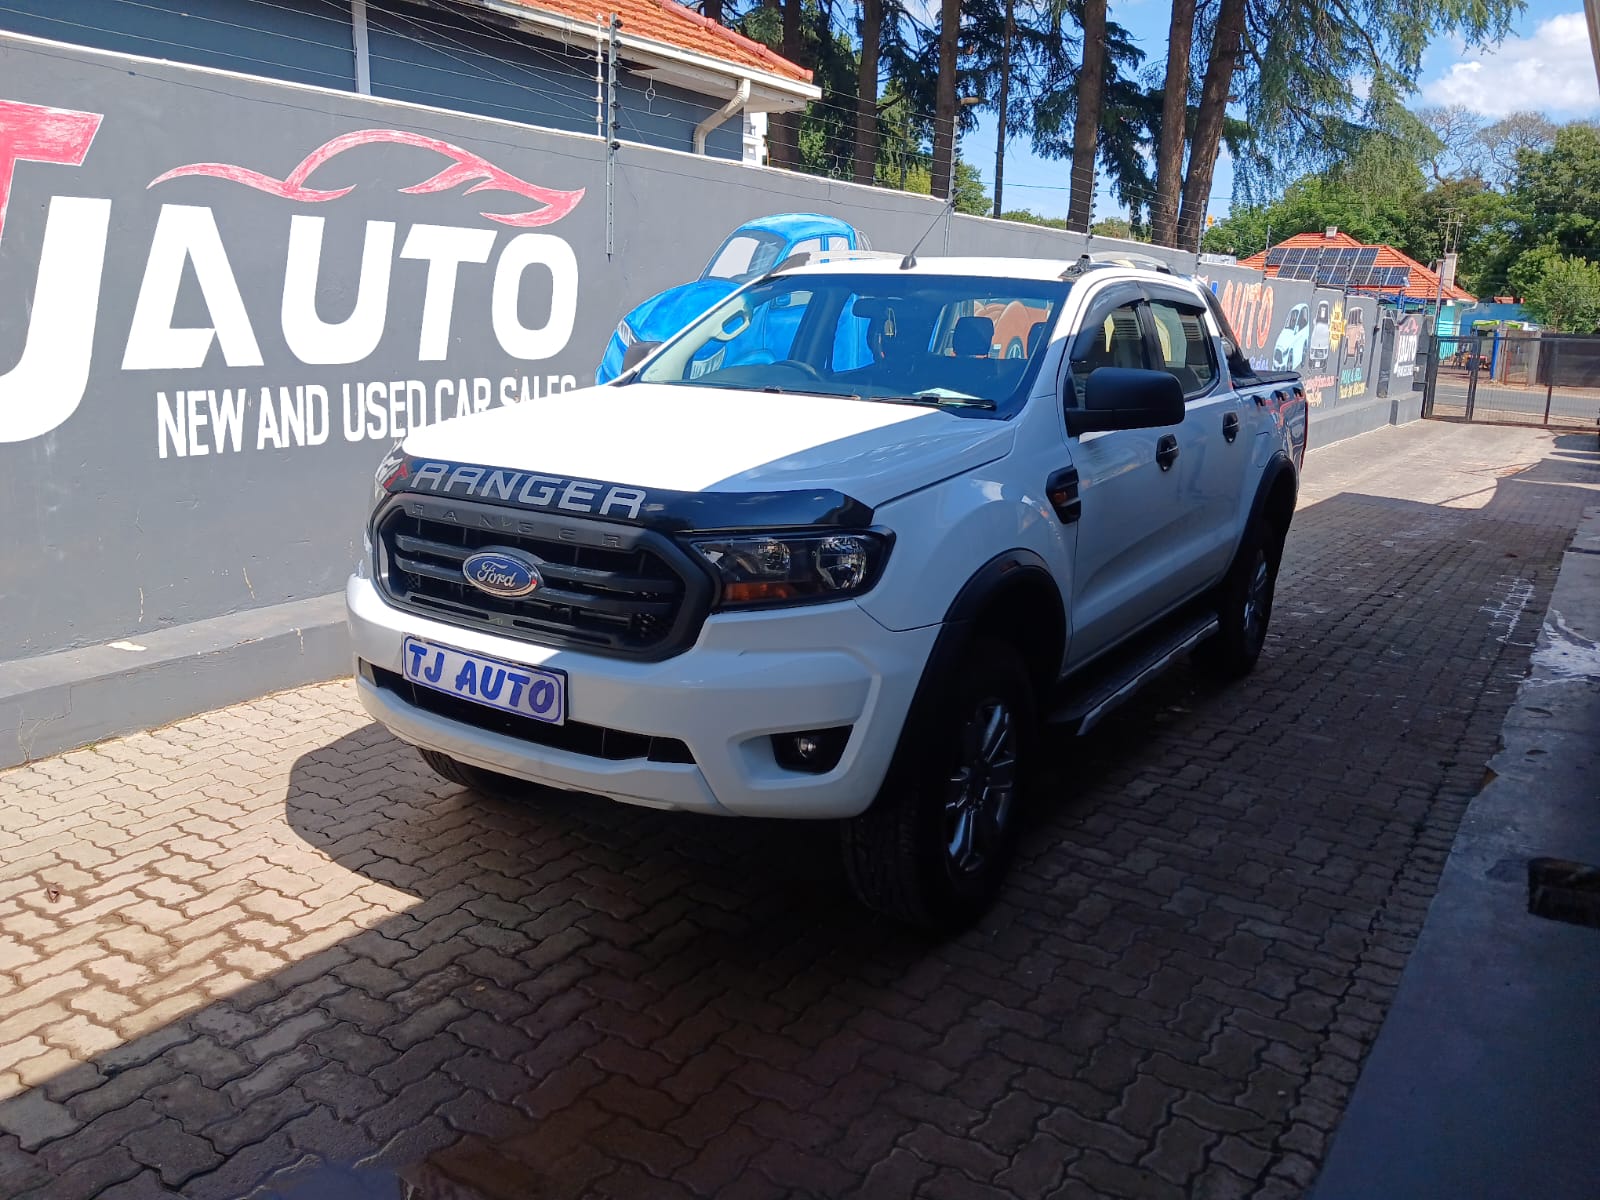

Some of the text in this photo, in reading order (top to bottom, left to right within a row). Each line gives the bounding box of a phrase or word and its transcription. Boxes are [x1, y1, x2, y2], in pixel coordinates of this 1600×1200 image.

[120, 203, 579, 371] AUTO
[157, 388, 248, 459] NEW
[256, 384, 329, 450] AND
[342, 380, 427, 440] USED
[410, 463, 647, 519] RANGER
[476, 560, 517, 588] Ford
[409, 645, 555, 714] TJ AUTO
